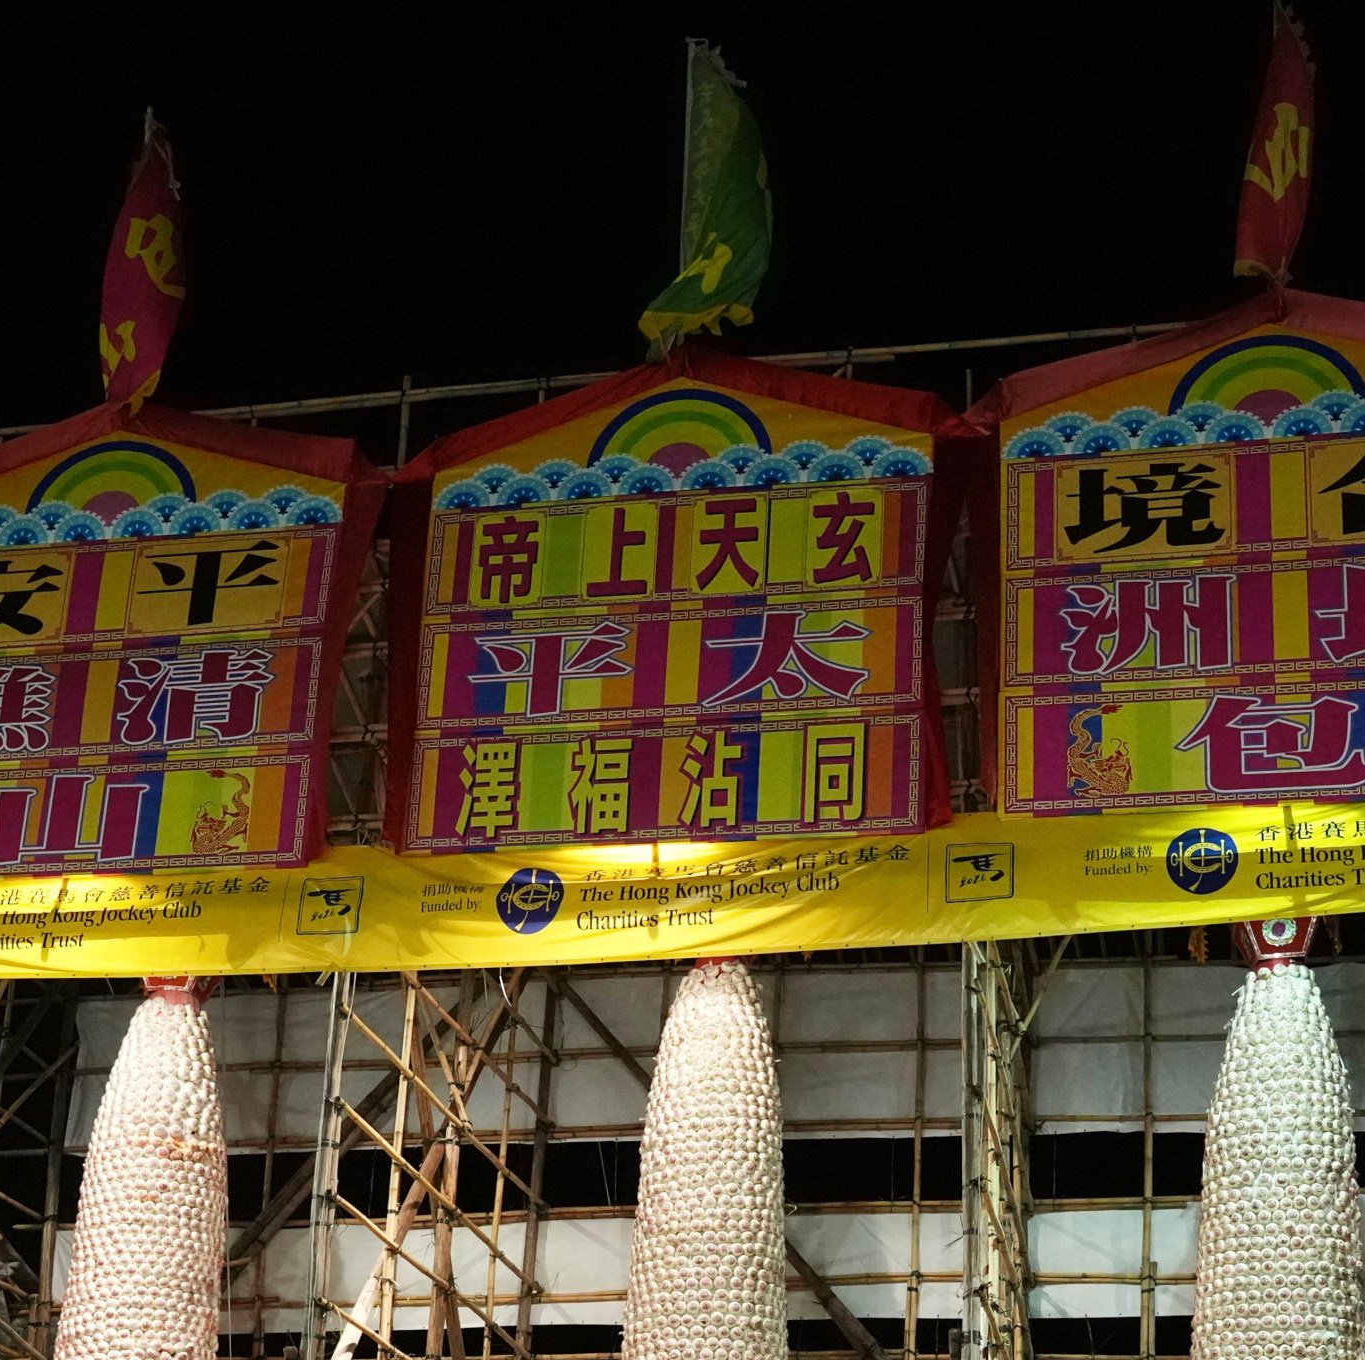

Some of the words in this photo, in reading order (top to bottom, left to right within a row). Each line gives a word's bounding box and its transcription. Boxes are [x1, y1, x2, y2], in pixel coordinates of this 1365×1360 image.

[477, 491, 876, 604] 玄天上帝
[455, 721, 869, 840] 同沾福澤
[1084, 846, 1153, 862] 捐助機構
[1255, 847, 1294, 865] The
[1300, 846, 1354, 867] Hong
[1084, 864, 1132, 877] Funded
[1256, 871, 1345, 890] Charities
[579, 887, 613, 902] The
[618, 884, 669, 905] Hong
[675, 880, 722, 902] Kong
[727, 877, 790, 902] Jockey
[796, 871, 839, 892] Club
[2, 910, 47, 929] Hong
[51, 907, 94, 928] Kong
[96, 904, 158, 926] Jockey
[162, 900, 202, 919] Club
[420, 899, 462, 913] Funded
[576, 910, 659, 931] Charities
[665, 906, 714, 926] Trust
[41, 931, 85, 949] Trust
